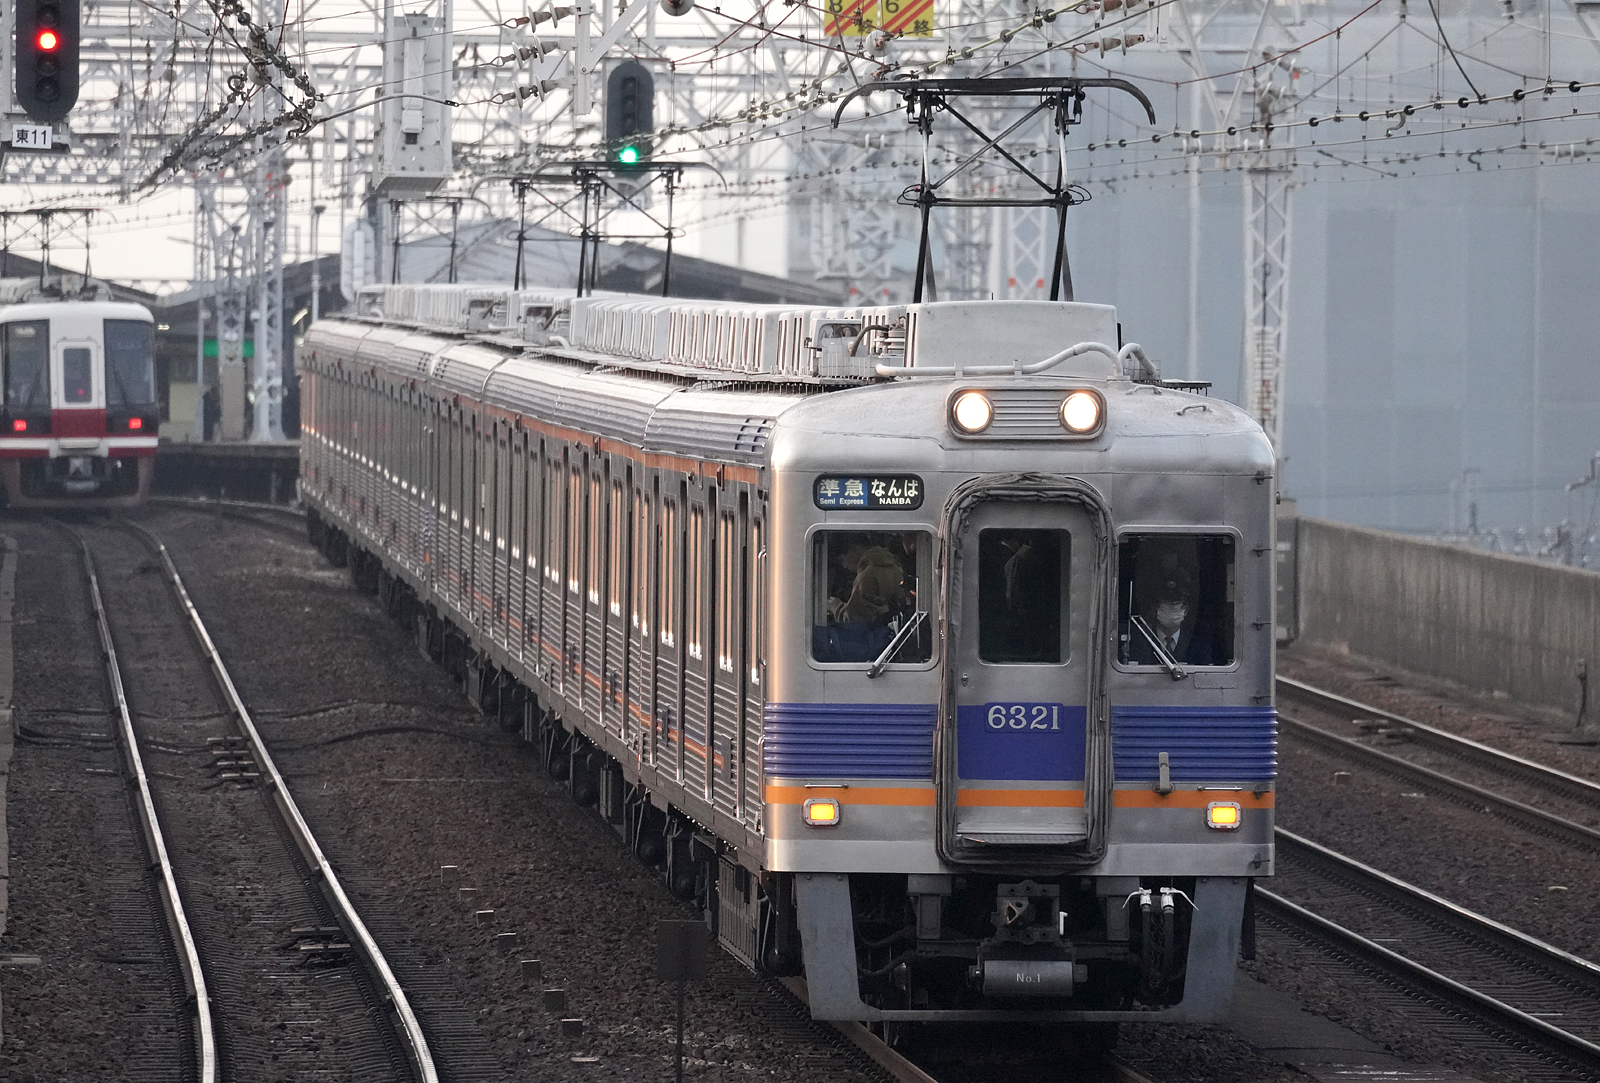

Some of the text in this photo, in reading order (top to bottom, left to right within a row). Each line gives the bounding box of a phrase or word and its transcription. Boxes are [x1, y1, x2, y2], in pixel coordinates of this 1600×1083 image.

[885, 0, 899, 13] 6
[16, 128, 47, 145] 東11
[819, 479, 919, 497] 準急 なんば
[839, 498, 864, 506] Express
[988, 705, 1060, 730] 6321
[1016, 973, 1041, 983] No.1
